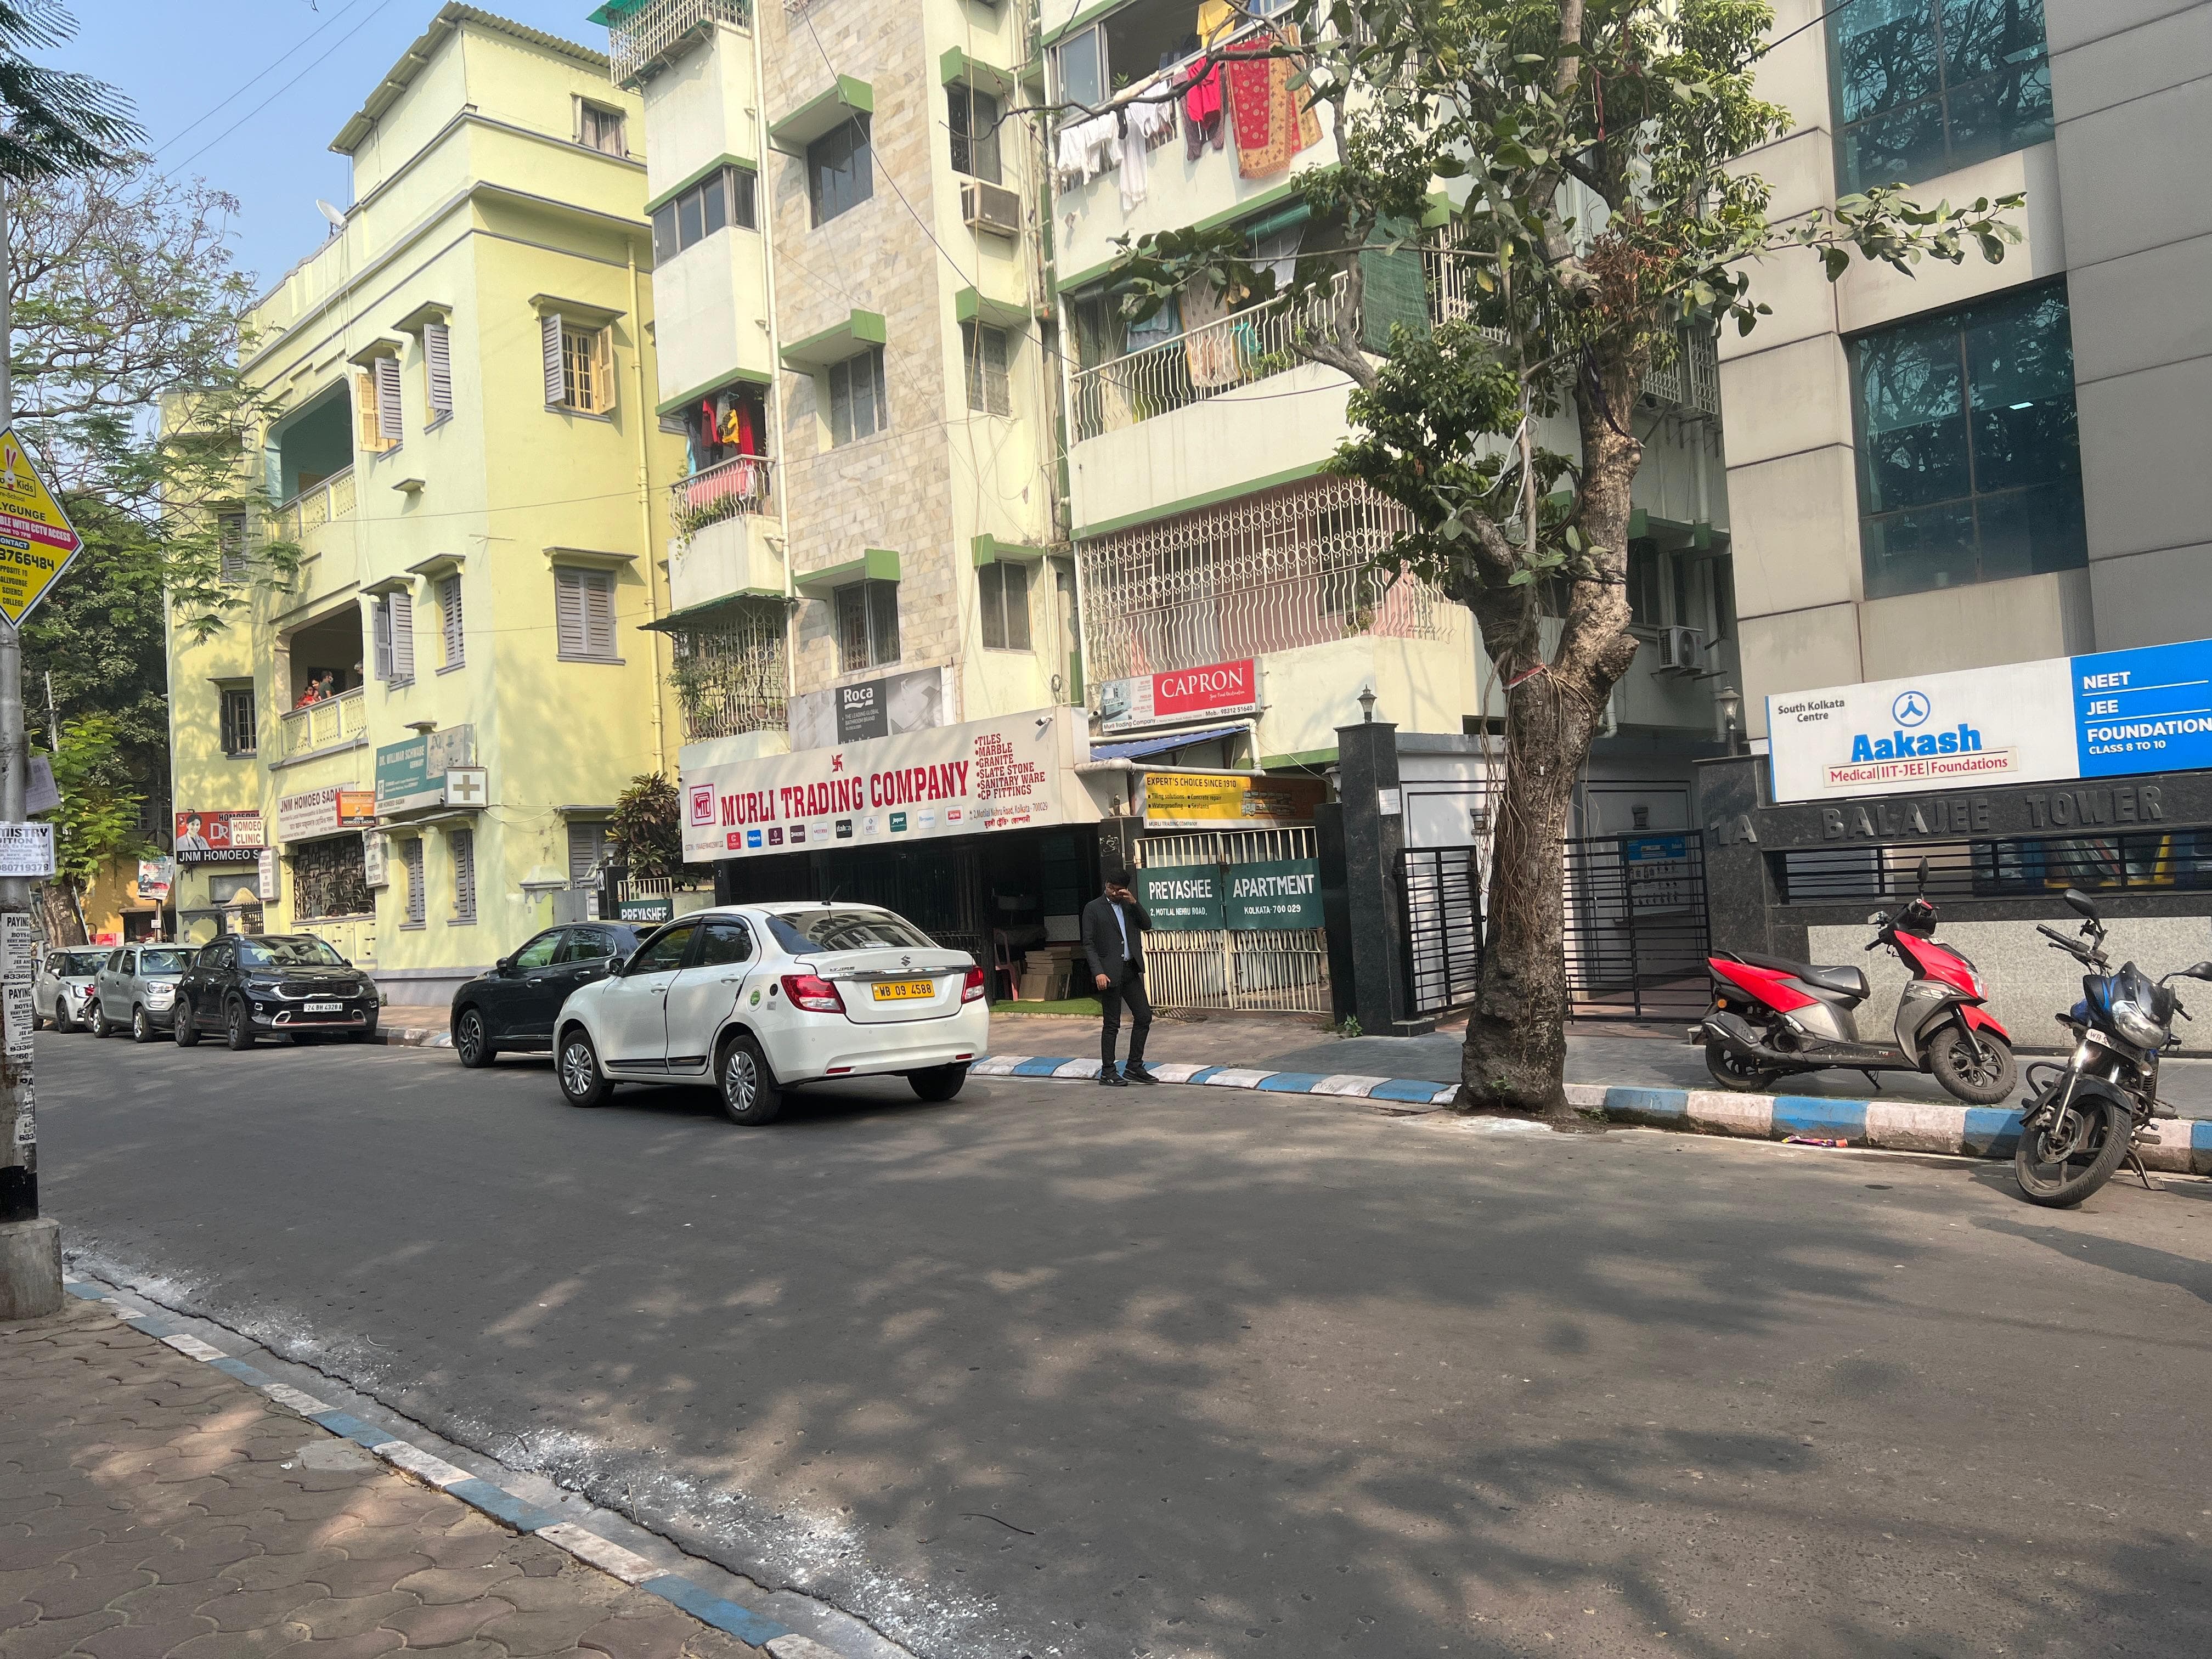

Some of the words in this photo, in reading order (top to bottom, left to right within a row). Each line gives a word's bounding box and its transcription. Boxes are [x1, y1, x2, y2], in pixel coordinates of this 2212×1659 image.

[16, 479, 33, 493] Kids
[0, 501, 46, 522] YGUNGE
[12, 518, 30, 531] WITH
[31, 523, 48, 536] CCTV
[48, 528, 71, 542] ACCESS
[0, 537, 27, 548] ONTACT
[2, 586, 23, 597] SCIENCE
[3, 597, 24, 607] COLLEGE
[1161, 668, 1243, 698] CAPRON
[2083, 671, 2131, 690] NEET
[844, 687, 873, 703] Roca
[1778, 702, 1806, 714] South
[1807, 698, 1845, 712] Kolkata
[2086, 699, 2119, 716] JEE
[1797, 712, 1829, 723] Centre
[2087, 717, 2212, 743] FOUNDATION
[978, 733, 1001, 746] TILES
[1851, 723, 1983, 763] Aakash
[979, 742, 1012, 757] MARBLE
[2089, 744, 2124, 755] CLASS
[2126, 743, 2133, 752] 8
[2135, 742, 2151, 751] TO
[2153, 740, 2166, 749] 10
[979, 754, 1013, 768] GRANITE
[980, 766, 1005, 778] SLATE
[1007, 762, 1034, 775] STONE
[980, 775, 1018, 789] SANITARY
[1021, 772, 1045, 784] WARE
[1147, 777, 1178, 786] EXPERT'S
[1180, 778, 1203, 787] CHOICE
[1204, 779, 1222, 787] SINCE
[721, 789, 775, 826] MURLI
[781, 776, 864, 819] TRADING
[870, 760, 968, 808] COMPANY
[981, 790, 991, 800] CP
[994, 784, 1031, 799] FITTINGS
[280, 798, 292, 813] JNM
[294, 792, 320, 809] HOMOEO
[990, 807, 1003, 817] Nehru
[1014, 804, 1030, 814] Kolkata
[1032, 802, 1048, 812] 700029
[1821, 798, 1990, 840] BALAJEE
[2027, 785, 2163, 828] TOWER
[233, 821, 262, 831] HOMOEO
[236, 833, 261, 844] CLINIC
[179, 851, 201, 862] JNM
[204, 850, 250, 861] HOMOEO
[1149, 879, 1213, 900] PREYASHEE
[1233, 874, 1314, 898] APARTMENT
[1176, 907, 1190, 916] NEHRU
[1287, 904, 1301, 913] 029
[879, 986, 891, 996] WB
[895, 985, 906, 996] 09
[911, 984, 932, 994] 4588
